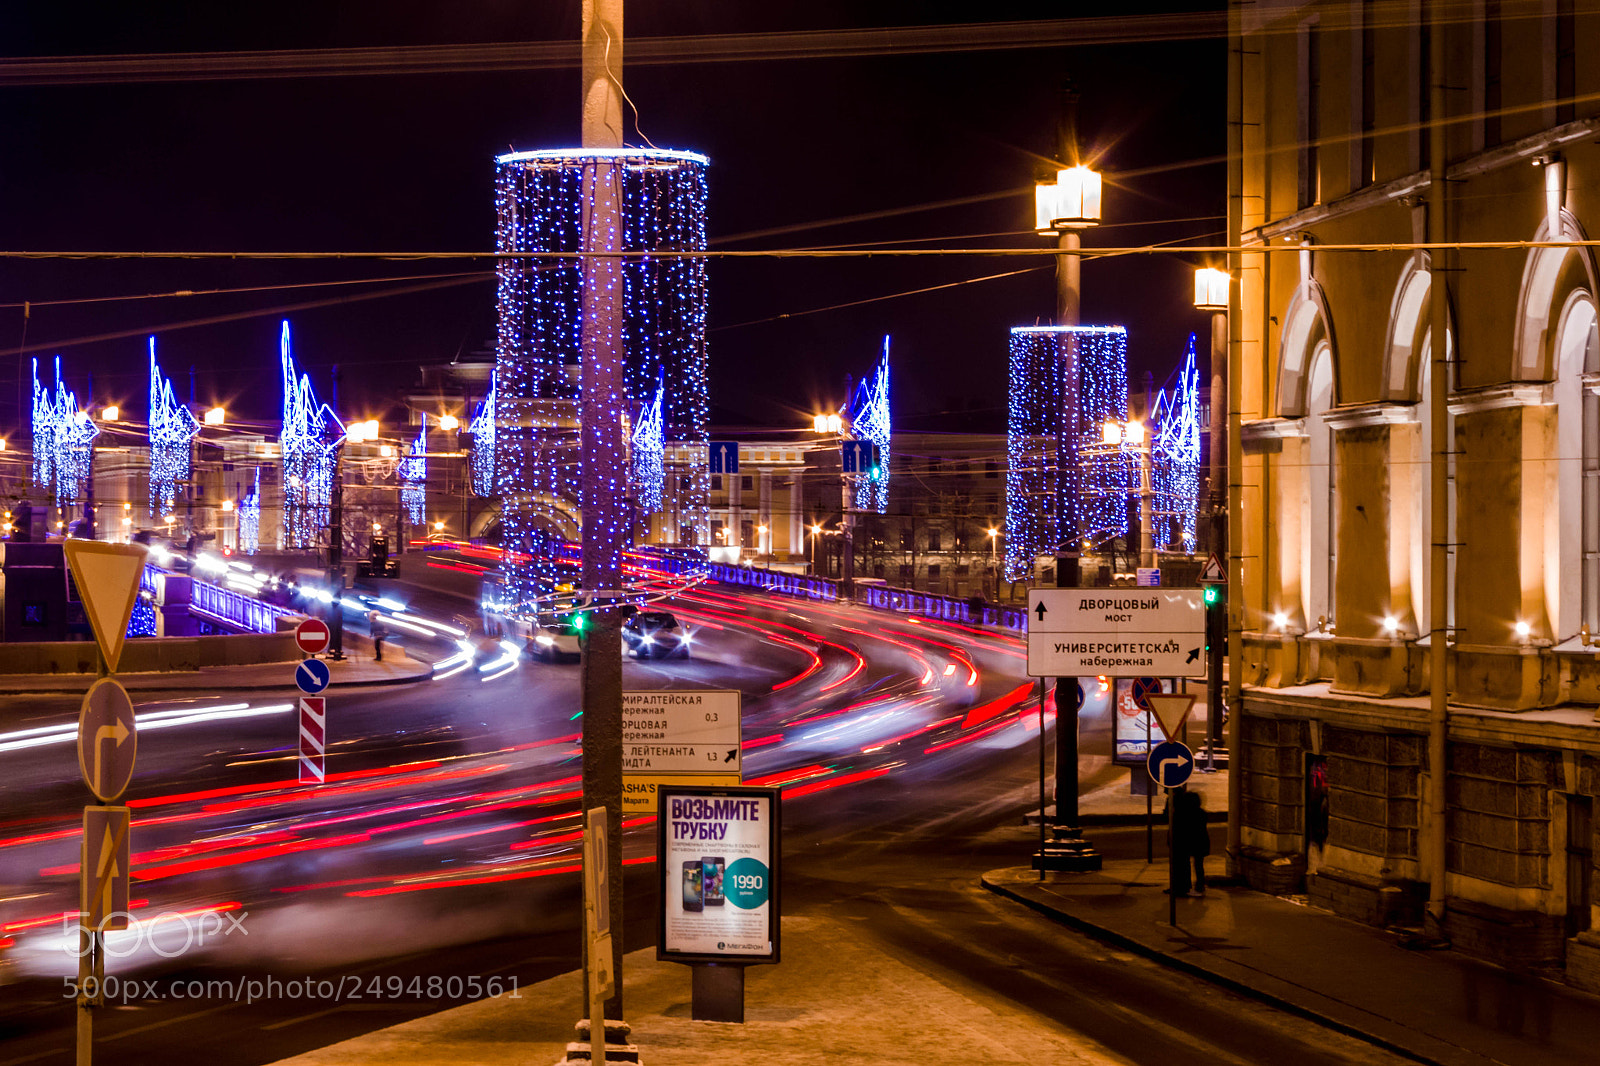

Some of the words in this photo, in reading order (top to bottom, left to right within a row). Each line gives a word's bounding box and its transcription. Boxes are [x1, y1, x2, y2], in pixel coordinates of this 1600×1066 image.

[1079, 597, 1159, 611] ДВОРЦОВЫЙ
[1105, 614, 1133, 622] мост
[1054, 643, 1180, 653] УНИВЕРСИТЕТСКАЯ
[1080, 655, 1153, 668] набережная
[622, 694, 702, 705] МИРАЛТЕЙСКАЯ
[621, 707, 665, 716] ережная
[621, 720, 668, 730] ОРЦОВАЯ
[621, 732, 665, 740] ережная
[630, 746, 696, 756] ЛЕЙТЕНАНТА
[621, 784, 656, 793] ASHA'S
[623, 797, 650, 805] Марата
[672, 799, 759, 821] ВОЗЬМИТЕ
[672, 821, 728, 840] ТРУБКУ
[732, 875, 763, 889] 1990
